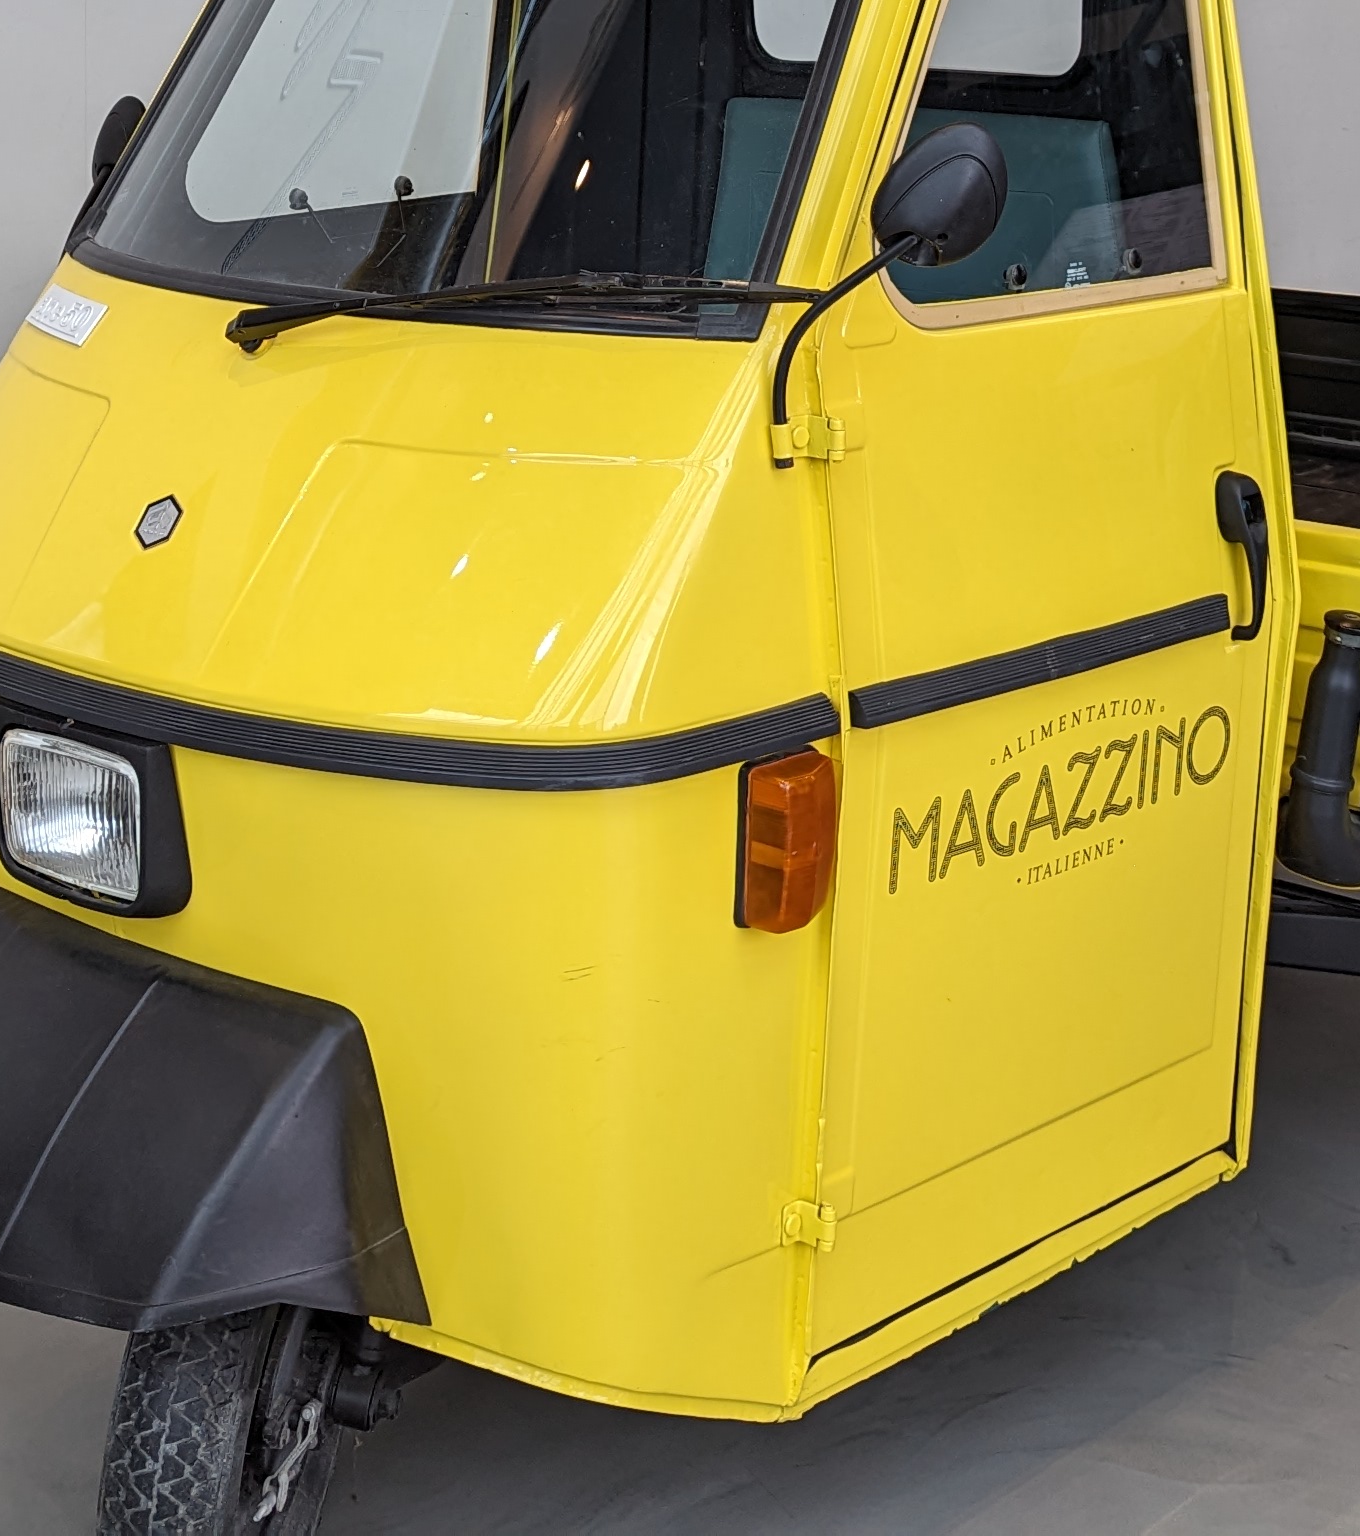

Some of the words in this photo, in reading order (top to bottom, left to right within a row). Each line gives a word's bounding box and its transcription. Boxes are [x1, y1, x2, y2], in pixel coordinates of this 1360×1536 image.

[1002, 698, 1156, 763] ALIMENTATION
[889, 706, 1231, 894] MAGAZZINO
[1026, 838, 1115, 885] ITALIENNE
